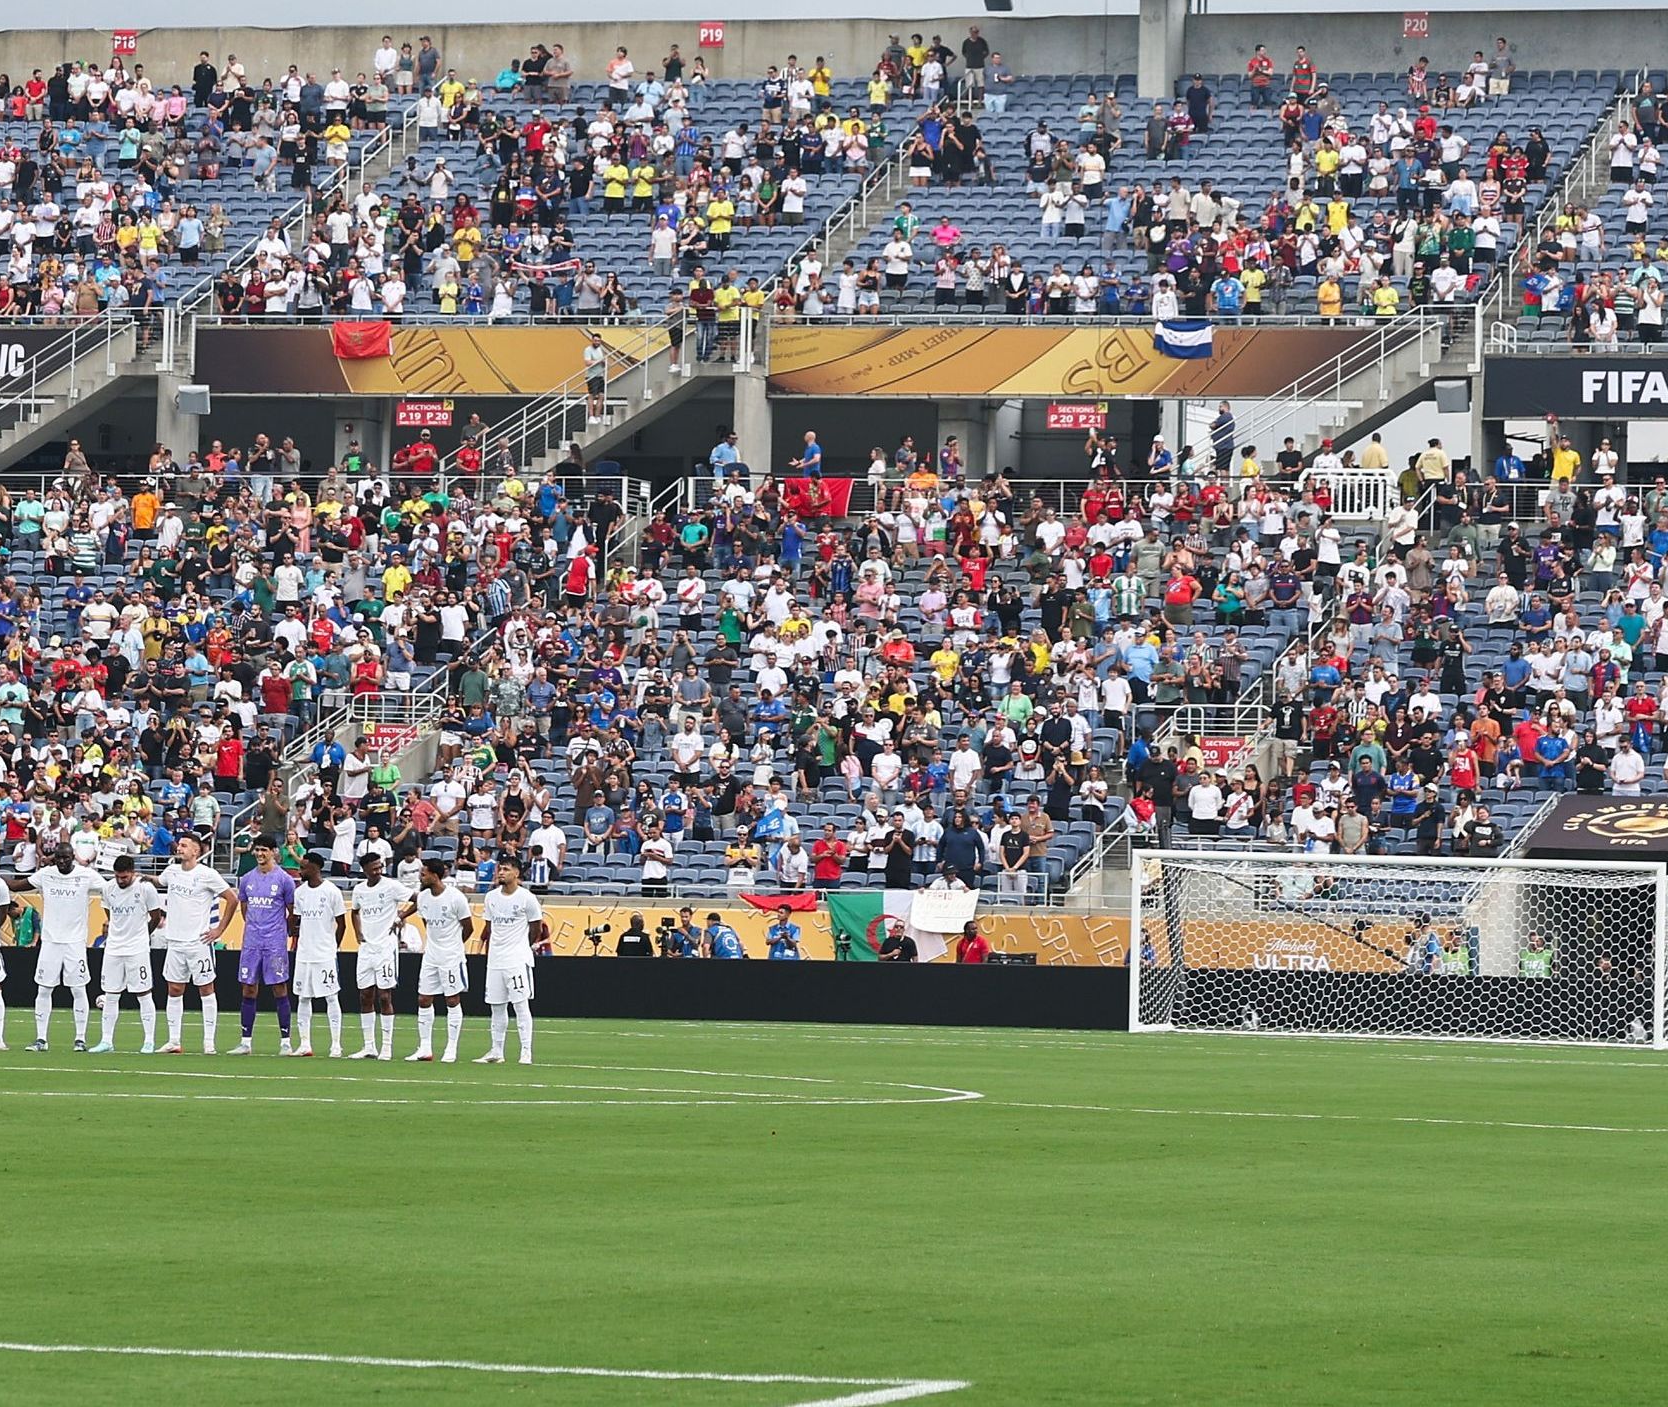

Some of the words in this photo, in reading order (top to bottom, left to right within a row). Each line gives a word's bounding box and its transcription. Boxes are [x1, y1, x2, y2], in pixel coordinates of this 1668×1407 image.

[1404, 19, 1428, 32] P20
[700, 28, 722, 41] P19
[114, 35, 136, 48] P18
[247, 896, 274, 905] SAVVY
[78, 960, 86, 973] 3
[198, 959, 212, 974] 22
[1254, 954, 1331, 971] ULTRA
[139, 966, 147, 980] 8
[322, 970, 334, 983] 24
[383, 964, 393, 977] 16
[512, 975, 524, 989] 11
